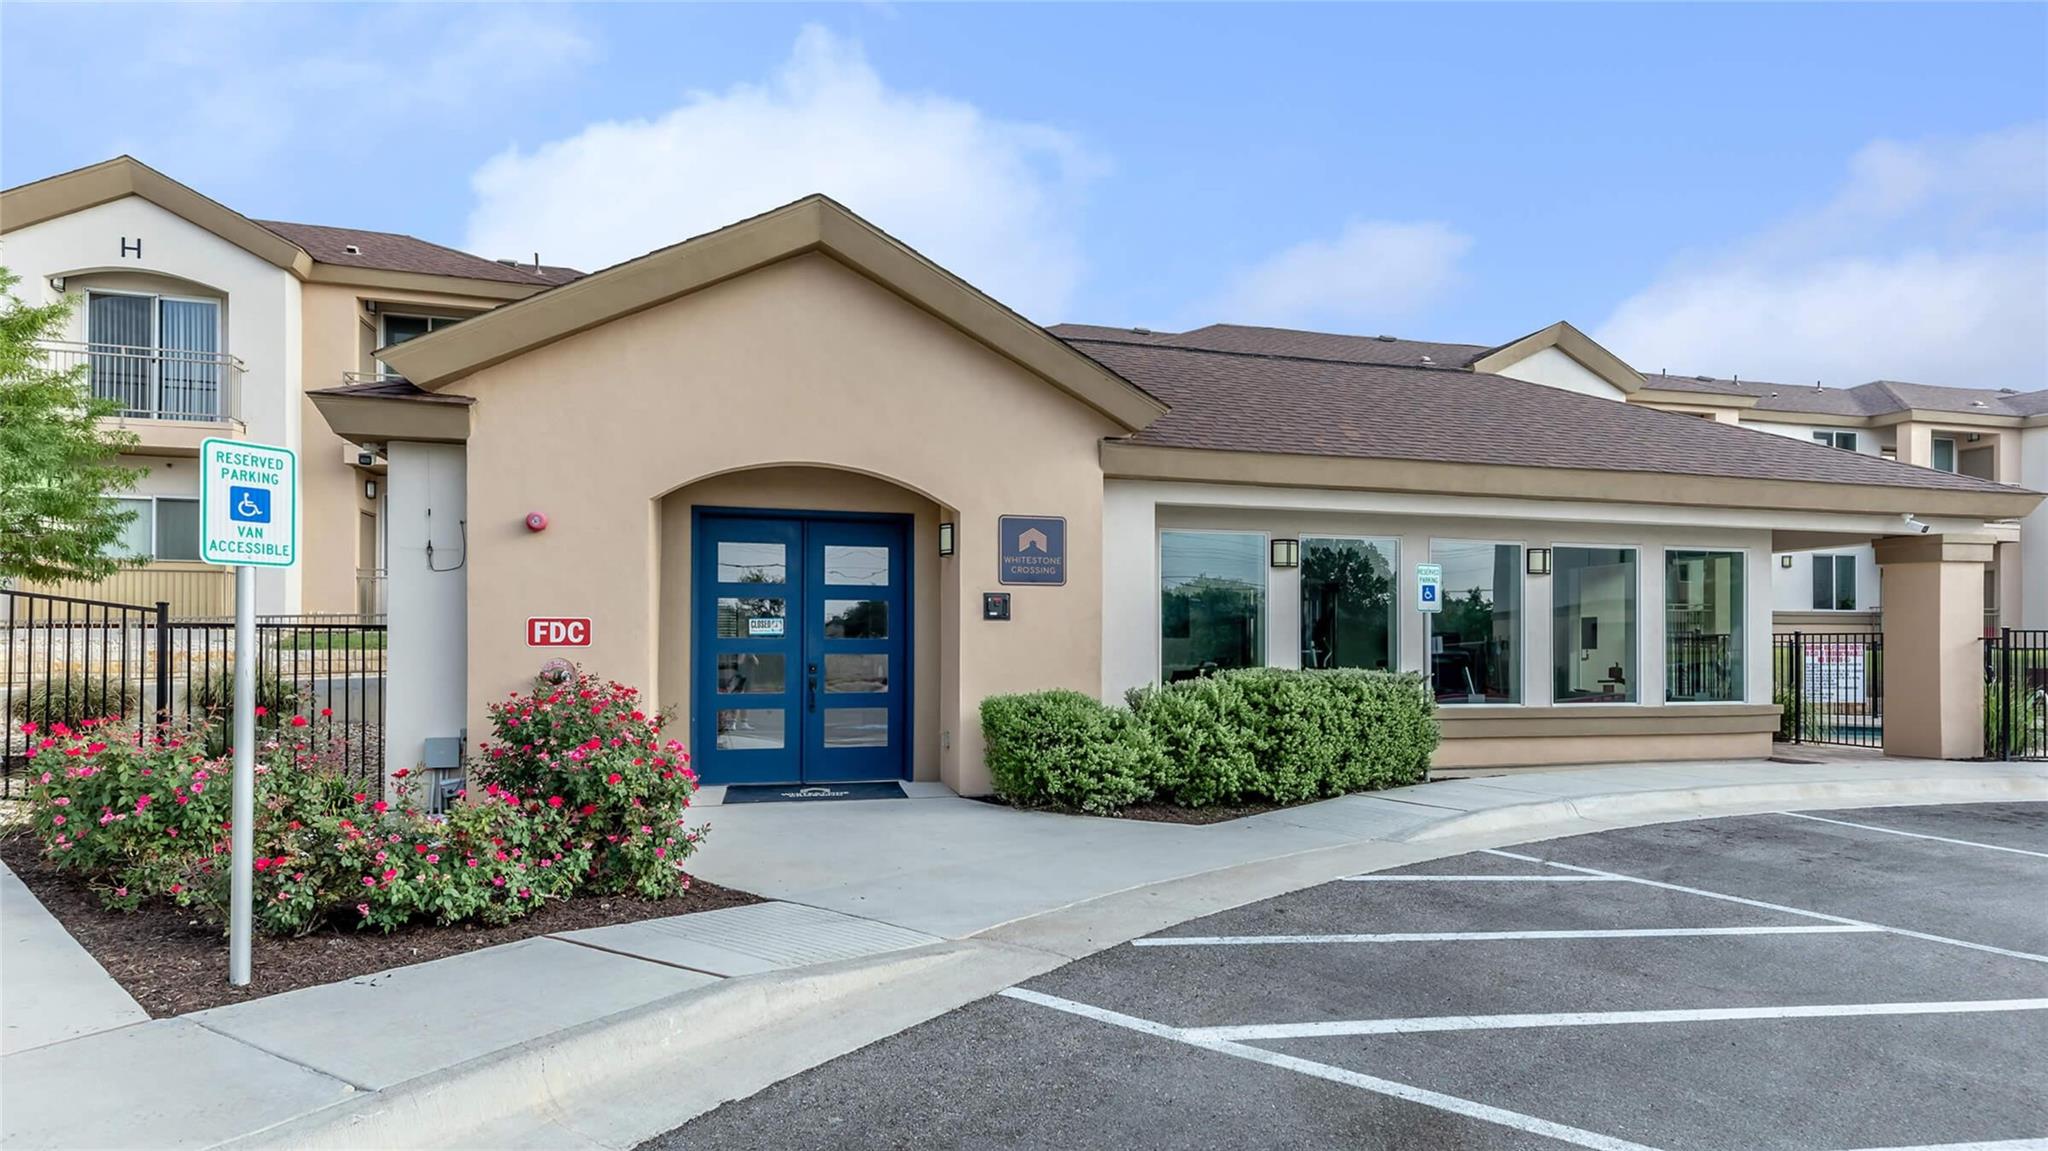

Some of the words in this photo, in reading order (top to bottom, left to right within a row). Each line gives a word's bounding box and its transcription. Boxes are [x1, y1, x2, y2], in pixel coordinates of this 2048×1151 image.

[121, 236, 141, 259] H
[216, 451, 284, 470] RESERVED
[221, 468, 279, 485] PARKING
[237, 526, 263, 538] VAN
[209, 539, 290, 557] ACCESSIBLE
[1003, 555, 1062, 565] WHITESTONE
[1010, 566, 1056, 575] CROSSING
[534, 621, 584, 643] FDC
[750, 620, 771, 628] CLOSED
